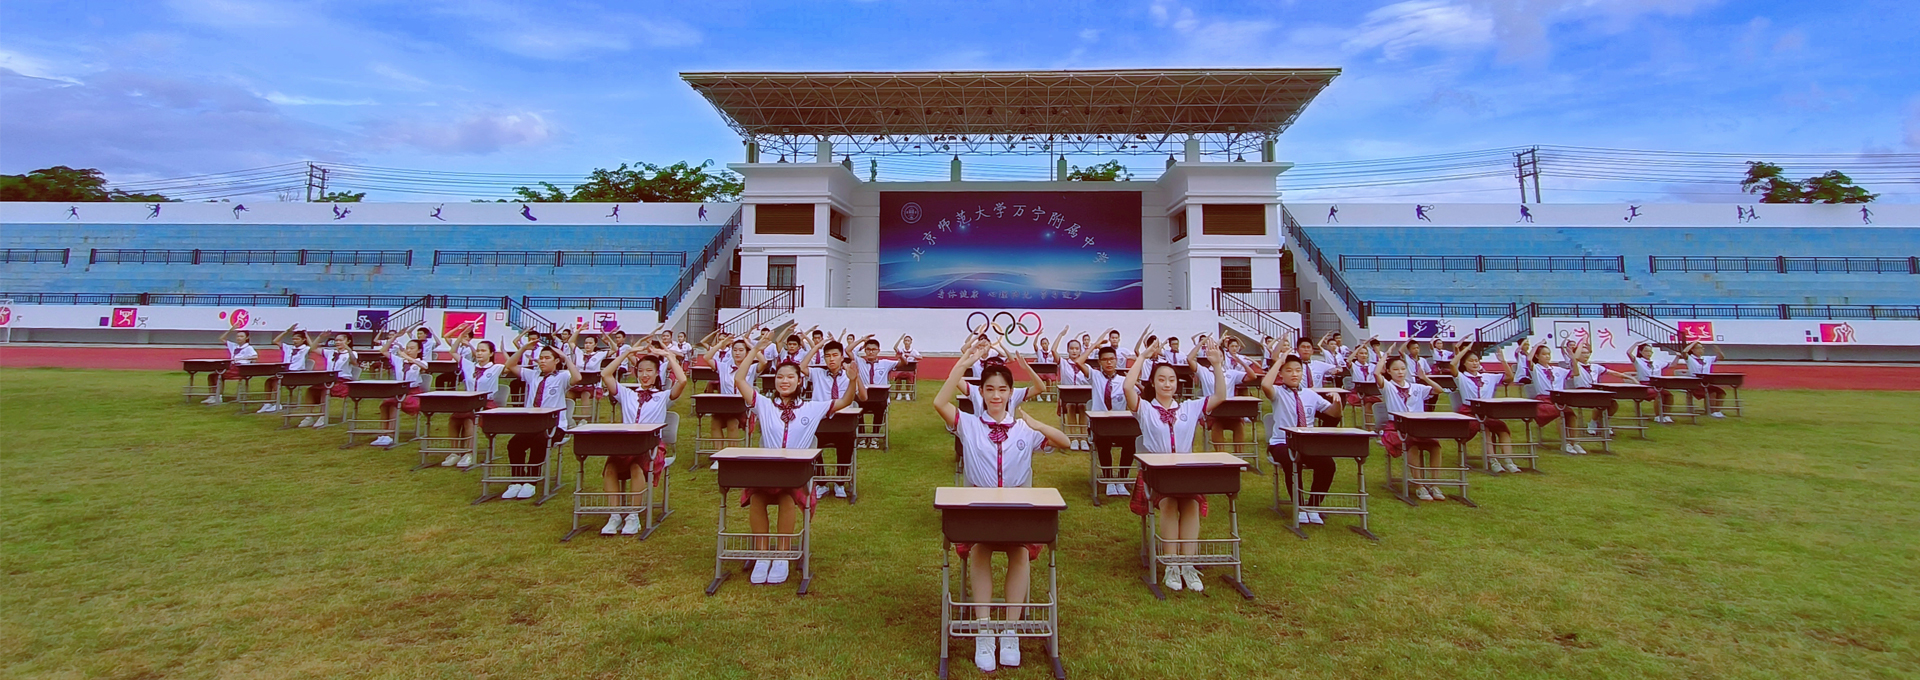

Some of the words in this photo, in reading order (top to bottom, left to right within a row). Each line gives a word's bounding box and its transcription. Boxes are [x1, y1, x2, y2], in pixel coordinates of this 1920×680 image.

[911, 201, 1110, 263] 北京师范大学万宁附属中学
